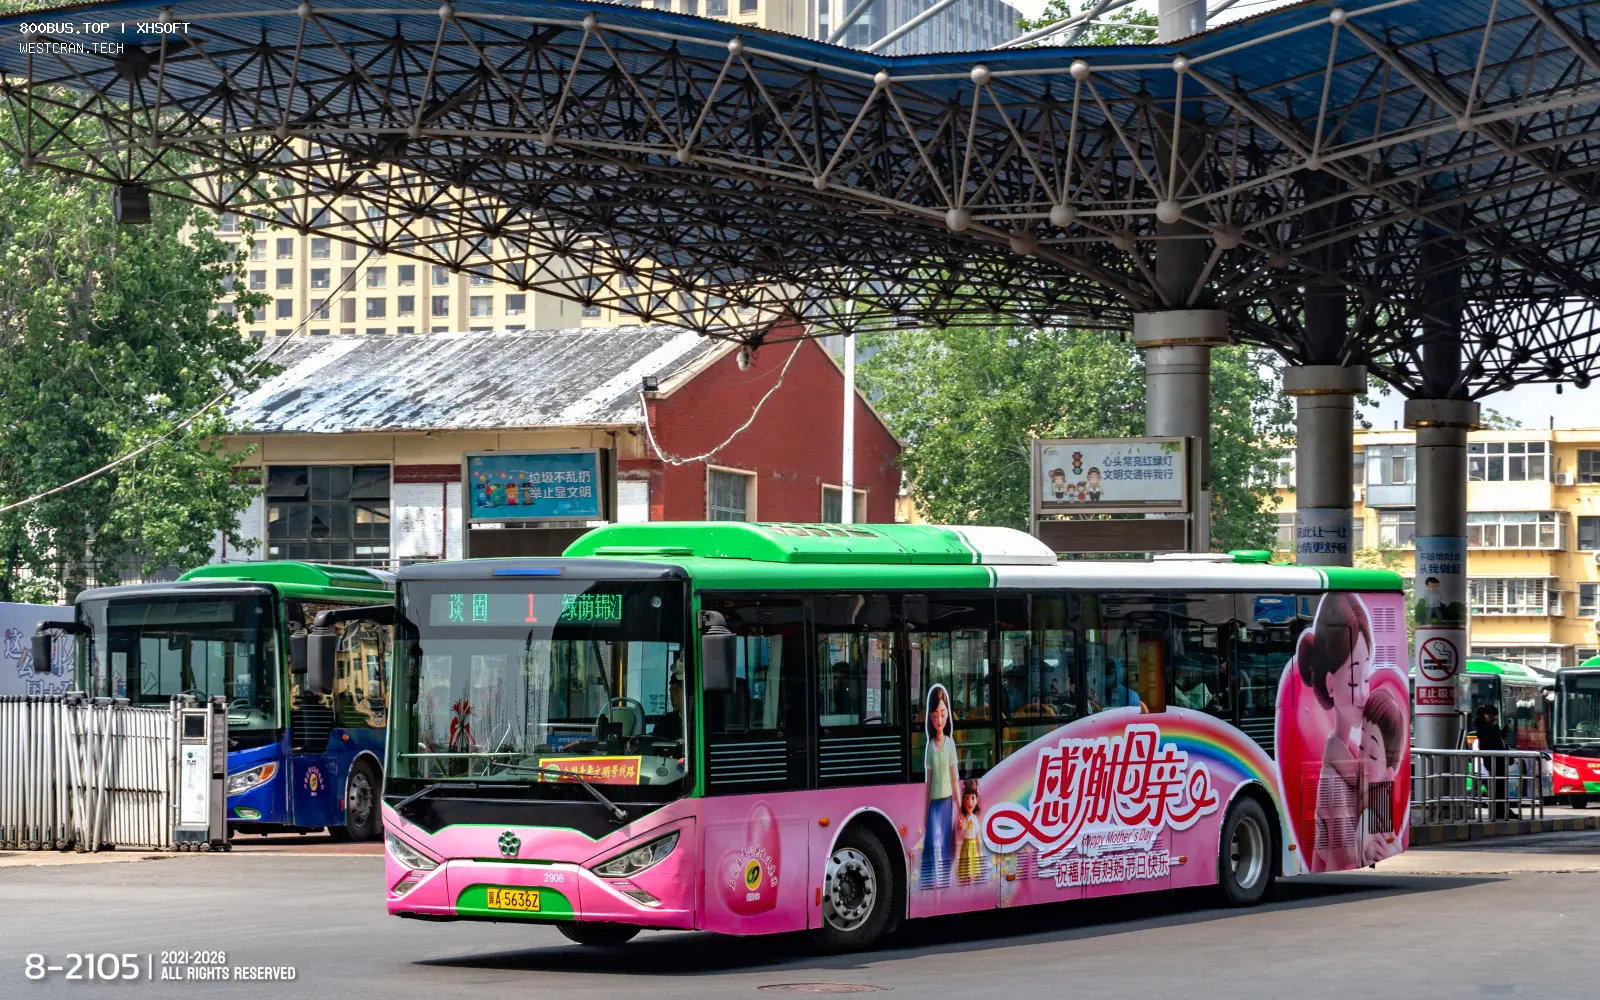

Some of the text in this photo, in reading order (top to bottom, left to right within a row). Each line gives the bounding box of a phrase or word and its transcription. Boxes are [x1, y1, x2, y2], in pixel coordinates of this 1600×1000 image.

[1102, 455, 1173, 467] 心头常亮红绿灯
[528, 470, 591, 484] 垃圾不乱扔
[1103, 468, 1174, 480] 文明交通伴我行
[529, 485, 592, 499] 举止显文明
[1419, 563, 1461, 575] 从我做起
[448, 593, 488, 622] 谈固
[525, 593, 538, 623] 1
[1418, 687, 1455, 699] 禁止吸
[987, 730, 1217, 859] 感谢母亲
[1056, 852, 1170, 884] 祝福所有妈妈节日快乐
[543, 872, 565, 883] 2906
